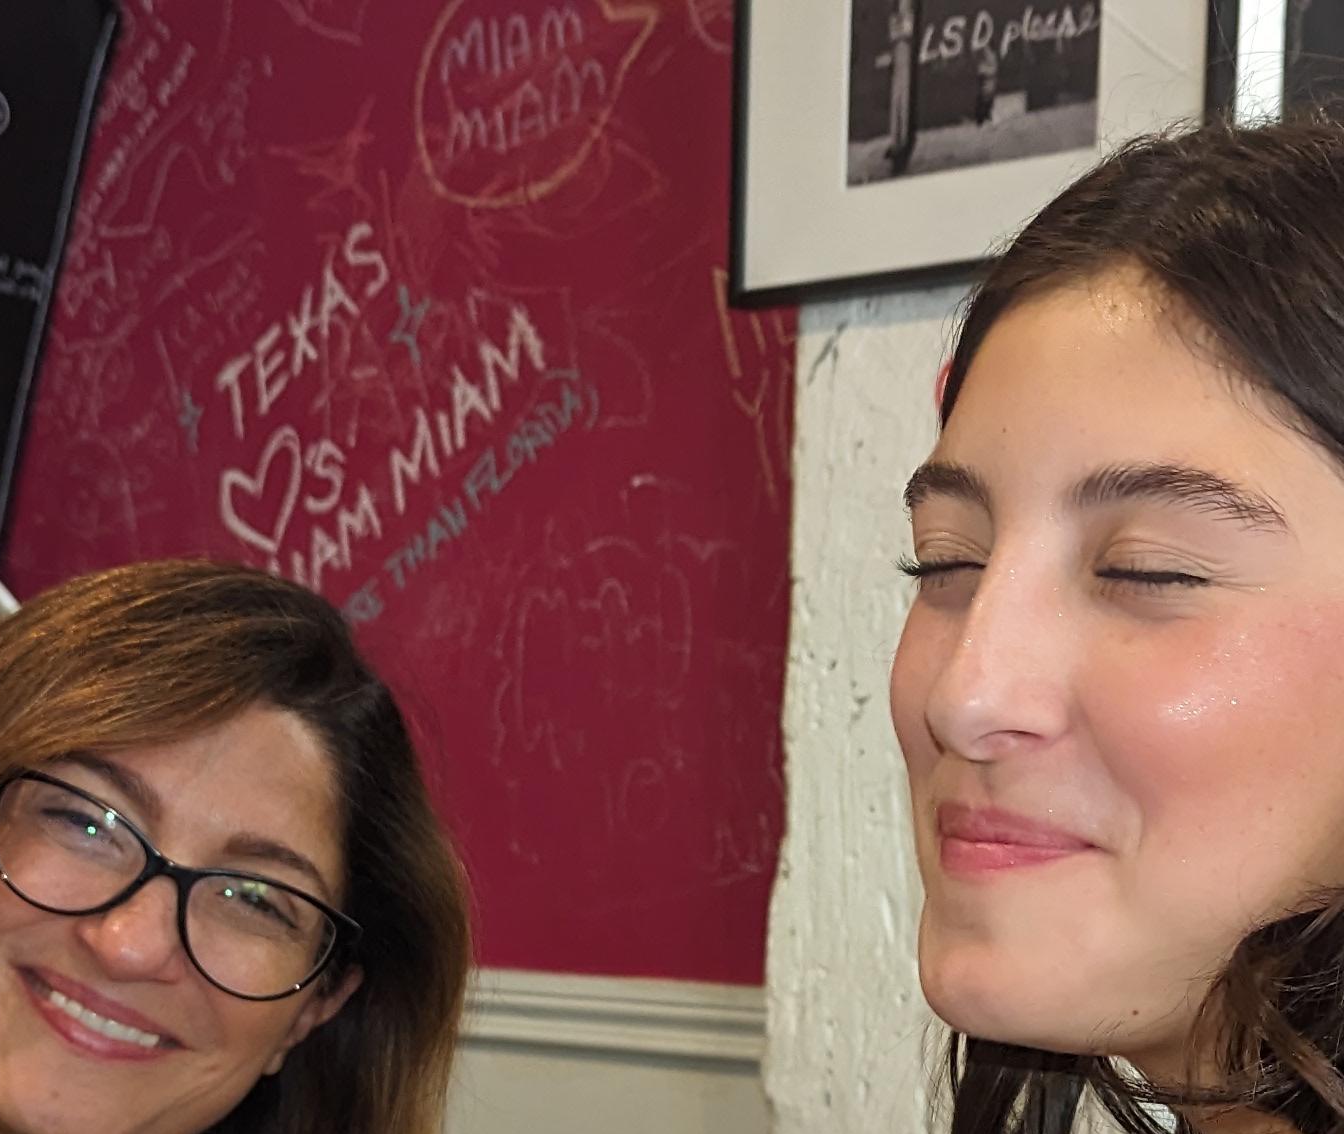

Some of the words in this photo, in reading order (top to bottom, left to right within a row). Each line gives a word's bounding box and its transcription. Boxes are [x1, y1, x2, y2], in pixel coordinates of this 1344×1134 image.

[440, 3, 584, 84] MIAM
[918, 10, 995, 64] LSD
[446, 55, 607, 159] MIAM
[216, 221, 390, 440] TEXAS
[269, 484, 383, 597] IAM
[389, 304, 545, 516] MIAM
[384, 497, 468, 592] THAN
